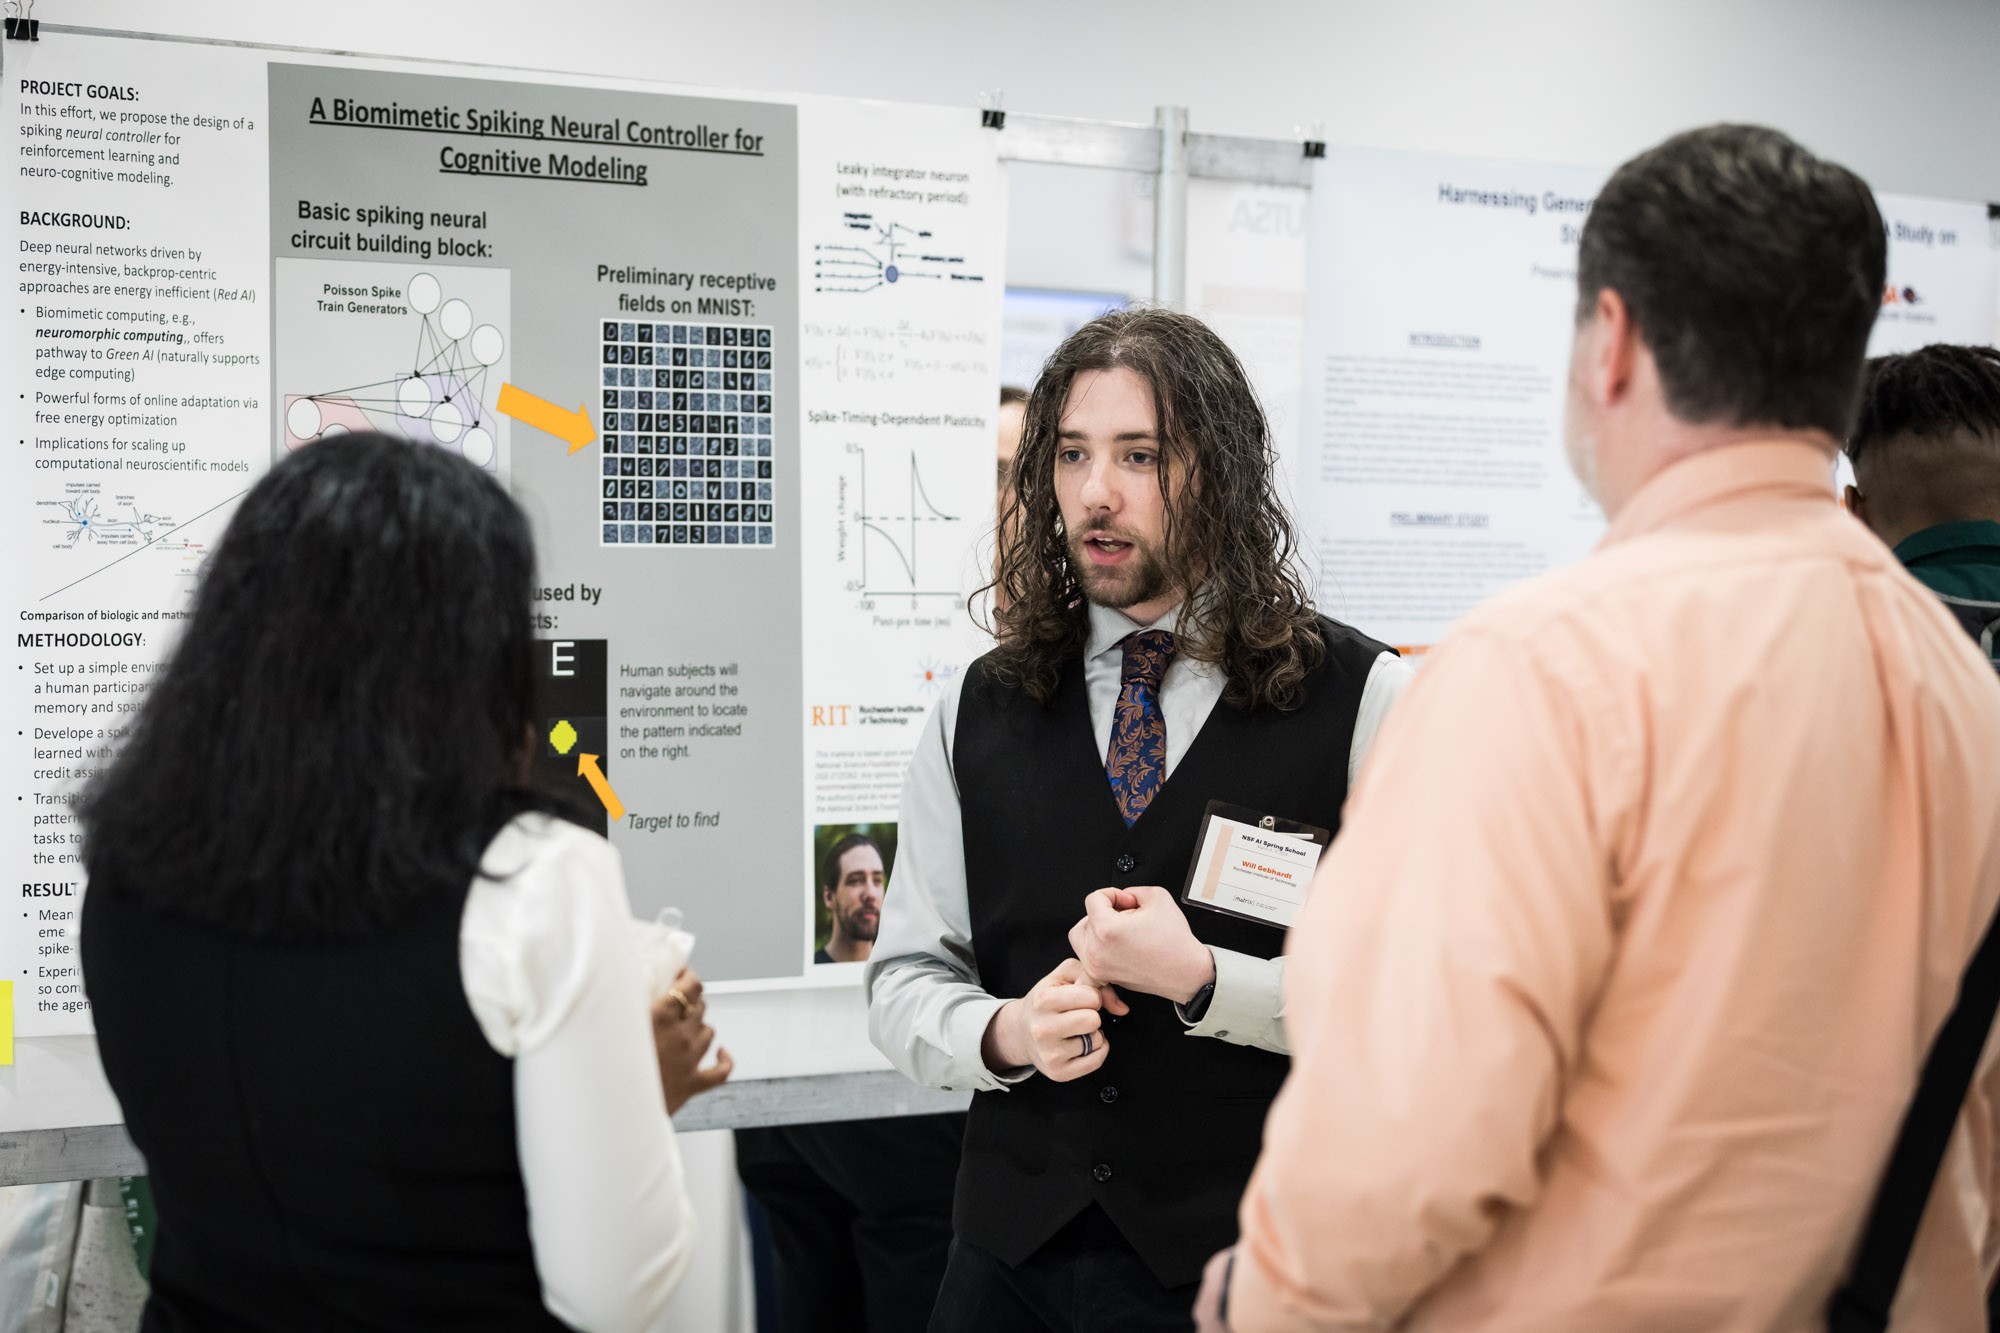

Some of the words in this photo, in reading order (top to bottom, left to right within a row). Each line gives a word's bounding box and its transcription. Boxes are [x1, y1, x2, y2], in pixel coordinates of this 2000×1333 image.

[21, 80, 82, 97] PROJECT
[87, 85, 138, 101] GOALS:
[61, 105, 95, 121] effort,
[120, 112, 167, 130] propose
[193, 115, 229, 130] design
[309, 97, 325, 120] A
[333, 98, 460, 129] Biomimetic
[467, 109, 544, 139] Spiking
[552, 115, 619, 140] Neural
[627, 121, 729, 149] Controller
[735, 129, 763, 151] for
[21, 124, 62, 140] spiking
[66, 128, 102, 139] neural
[106, 131, 161, 143] controller
[21, 144, 104, 160] reinforcement
[109, 149, 154, 166] learning
[440, 146, 541, 174] Cognitive
[549, 154, 648, 185] Modeling
[837, 164, 868, 177] Leaky
[872, 167, 926, 180] integrator
[930, 171, 969, 182] neuron
[20, 166, 114, 182] neuro-cognitive
[118, 171, 173, 187] modeling.
[837, 185, 865, 196] (with
[869, 186, 923, 202] refractory
[1439, 185, 1537, 215] Harnessing
[21, 211, 129, 230] BACKGROUND:
[299, 200, 350, 221] Basic
[357, 205, 423, 230] spiking
[431, 211, 486, 229] neural
[1895, 222, 1934, 245] Study
[21, 240, 51, 255] Deep
[56, 243, 92, 254] neural
[96, 245, 147, 257] networks
[151, 246, 184, 259] driven
[291, 230, 351, 250] circuit
[357, 233, 431, 259] building
[438, 237, 492, 257] block:
[20, 262, 120, 277] energy-intensive,
[124, 264, 216, 280] backprop-centric
[598, 264, 694, 291] Preliminary
[700, 273, 776, 293] receptive
[20, 281, 89, 294] approaches
[114, 287, 152, 299] energy
[155, 286, 210, 299] inefficient
[214, 288, 237, 301] (Red
[240, 290, 255, 303] AI)
[324, 284, 368, 296] Poisson
[372, 286, 401, 299] Spike
[317, 300, 343, 312] Train
[348, 302, 407, 315] Generators
[619, 293, 665, 313] fields
[698, 298, 754, 316] MNIST:
[37, 306, 102, 319] Biomimetic
[107, 312, 168, 325] computing,
[172, 314, 195, 326] e.g.,
[36, 328, 120, 342] neuromorphic
[194, 332, 224, 344] offers
[36, 346, 87, 361] pathway
[106, 348, 139, 360] Green
[158, 349, 209, 365] (naturally
[213, 355, 259, 366] supports
[36, 366, 65, 380] edge
[70, 368, 134, 382] computing)
[36, 392, 89, 404] Powerful
[93, 392, 126, 405] forms
[144, 394, 177, 406] online
[182, 396, 239, 409] adaptation
[243, 400, 258, 408] via
[36, 411, 60, 423] free
[64, 415, 104, 426] energy
[108, 413, 176, 427] optimization
[36, 437, 108, 451] Implications
[132, 439, 168, 453] scaling
[35, 458, 122, 471] computational
[127, 459, 206, 471] neuroscientific
[211, 460, 248, 472] models
[533, 584, 574, 600] used
[581, 584, 601, 605] by
[21, 611, 84, 622] Comparison
[101, 610, 138, 622] biologic
[18, 633, 145, 647] METHODOLOGY:
[35, 662, 54, 673] Set
[78, 665, 85, 673] a
[89, 661, 127, 675] simple
[553, 642, 575, 676] E
[621, 665, 663, 677] Human
[668, 664, 716, 679] subjects
[719, 664, 738, 675] will
[35, 685, 41, 693] a
[46, 682, 89, 693] human
[620, 686, 671, 700] navigate
[675, 684, 716, 697] around
[35, 705, 87, 715] memory
[620, 705, 694, 718] environment
[698, 705, 709, 717] to
[712, 704, 747, 716] locate
[812, 705, 849, 726] RIT
[35, 727, 93, 741] Develope
[97, 730, 104, 738] a
[643, 726, 684, 740] pattern
[689, 724, 741, 736] indicated
[35, 747, 81, 759] learned
[639, 746, 658, 758] the
[662, 745, 689, 760] right.
[34, 767, 71, 779] credit
[628, 814, 672, 833] Target
[694, 812, 720, 826] find
[34, 832, 65, 844] tasks
[1263, 841, 1283, 851] Spring
[1285, 847, 1306, 856] School
[1241, 860, 1256, 870] Will
[1258, 865, 1292, 880] Gebhardt
